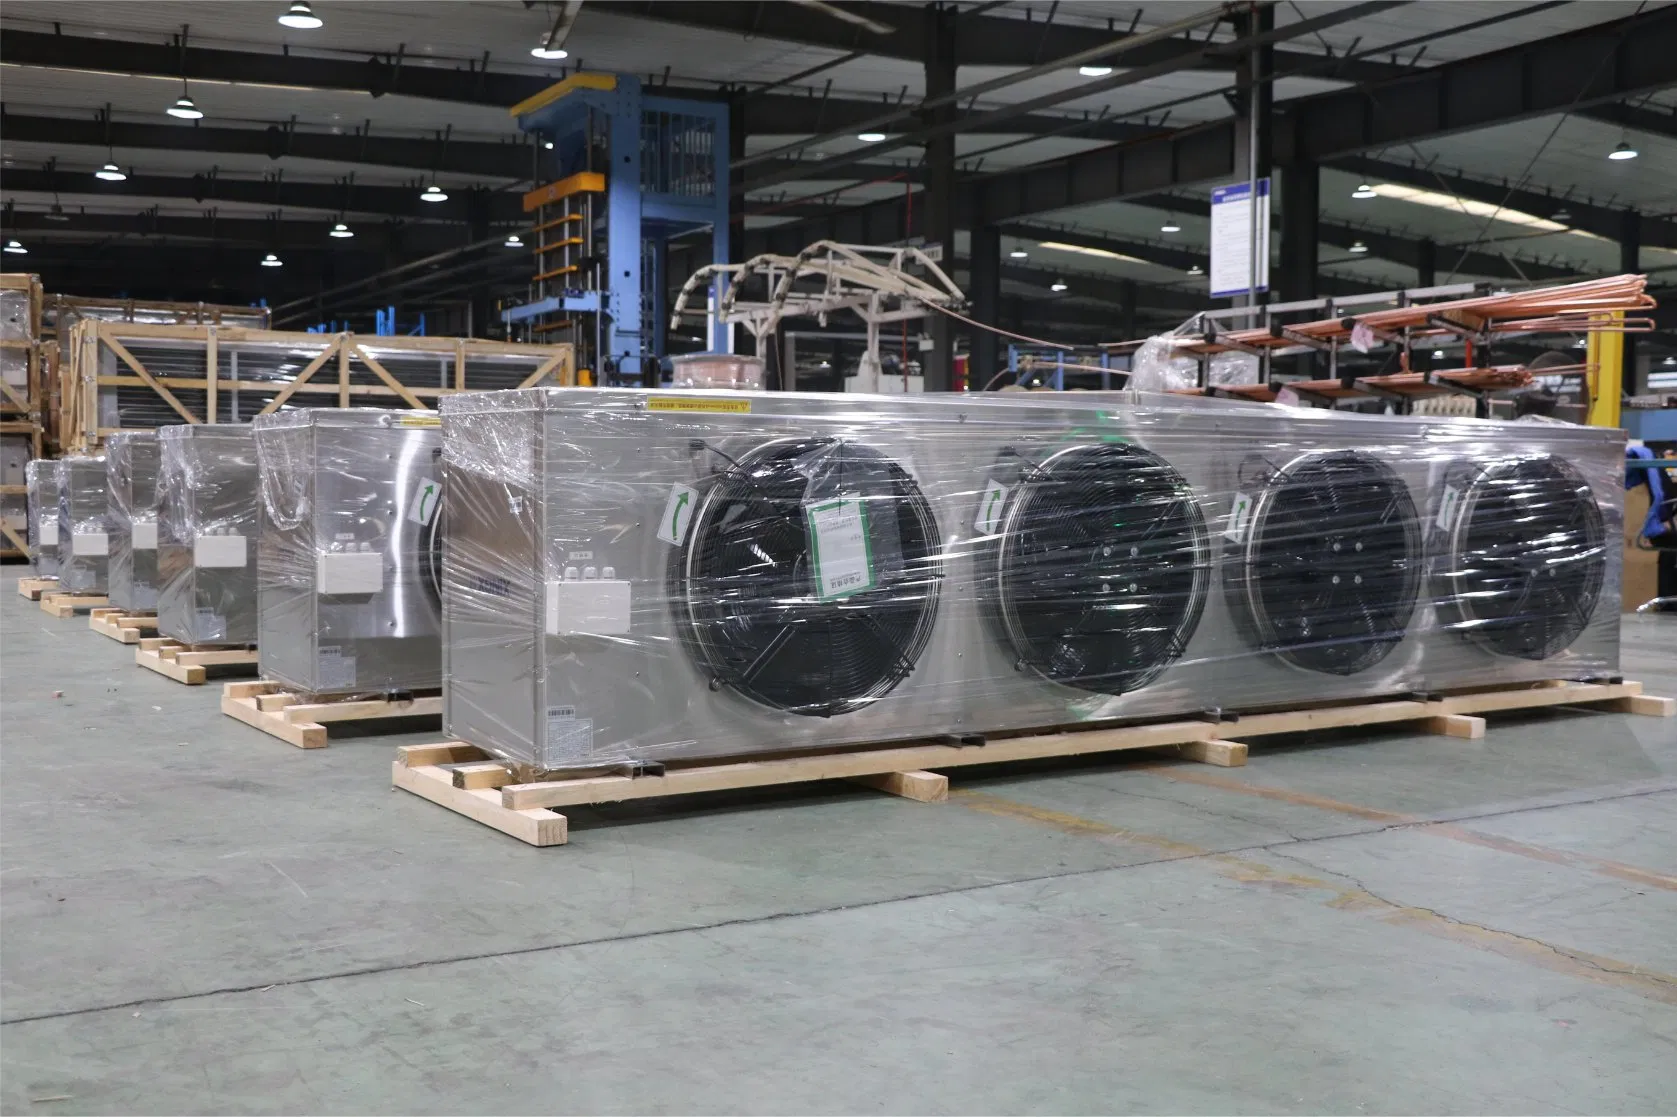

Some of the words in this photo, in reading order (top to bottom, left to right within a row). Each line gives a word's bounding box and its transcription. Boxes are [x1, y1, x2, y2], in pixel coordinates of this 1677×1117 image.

[831, 575, 861, 589] 产品合格证
